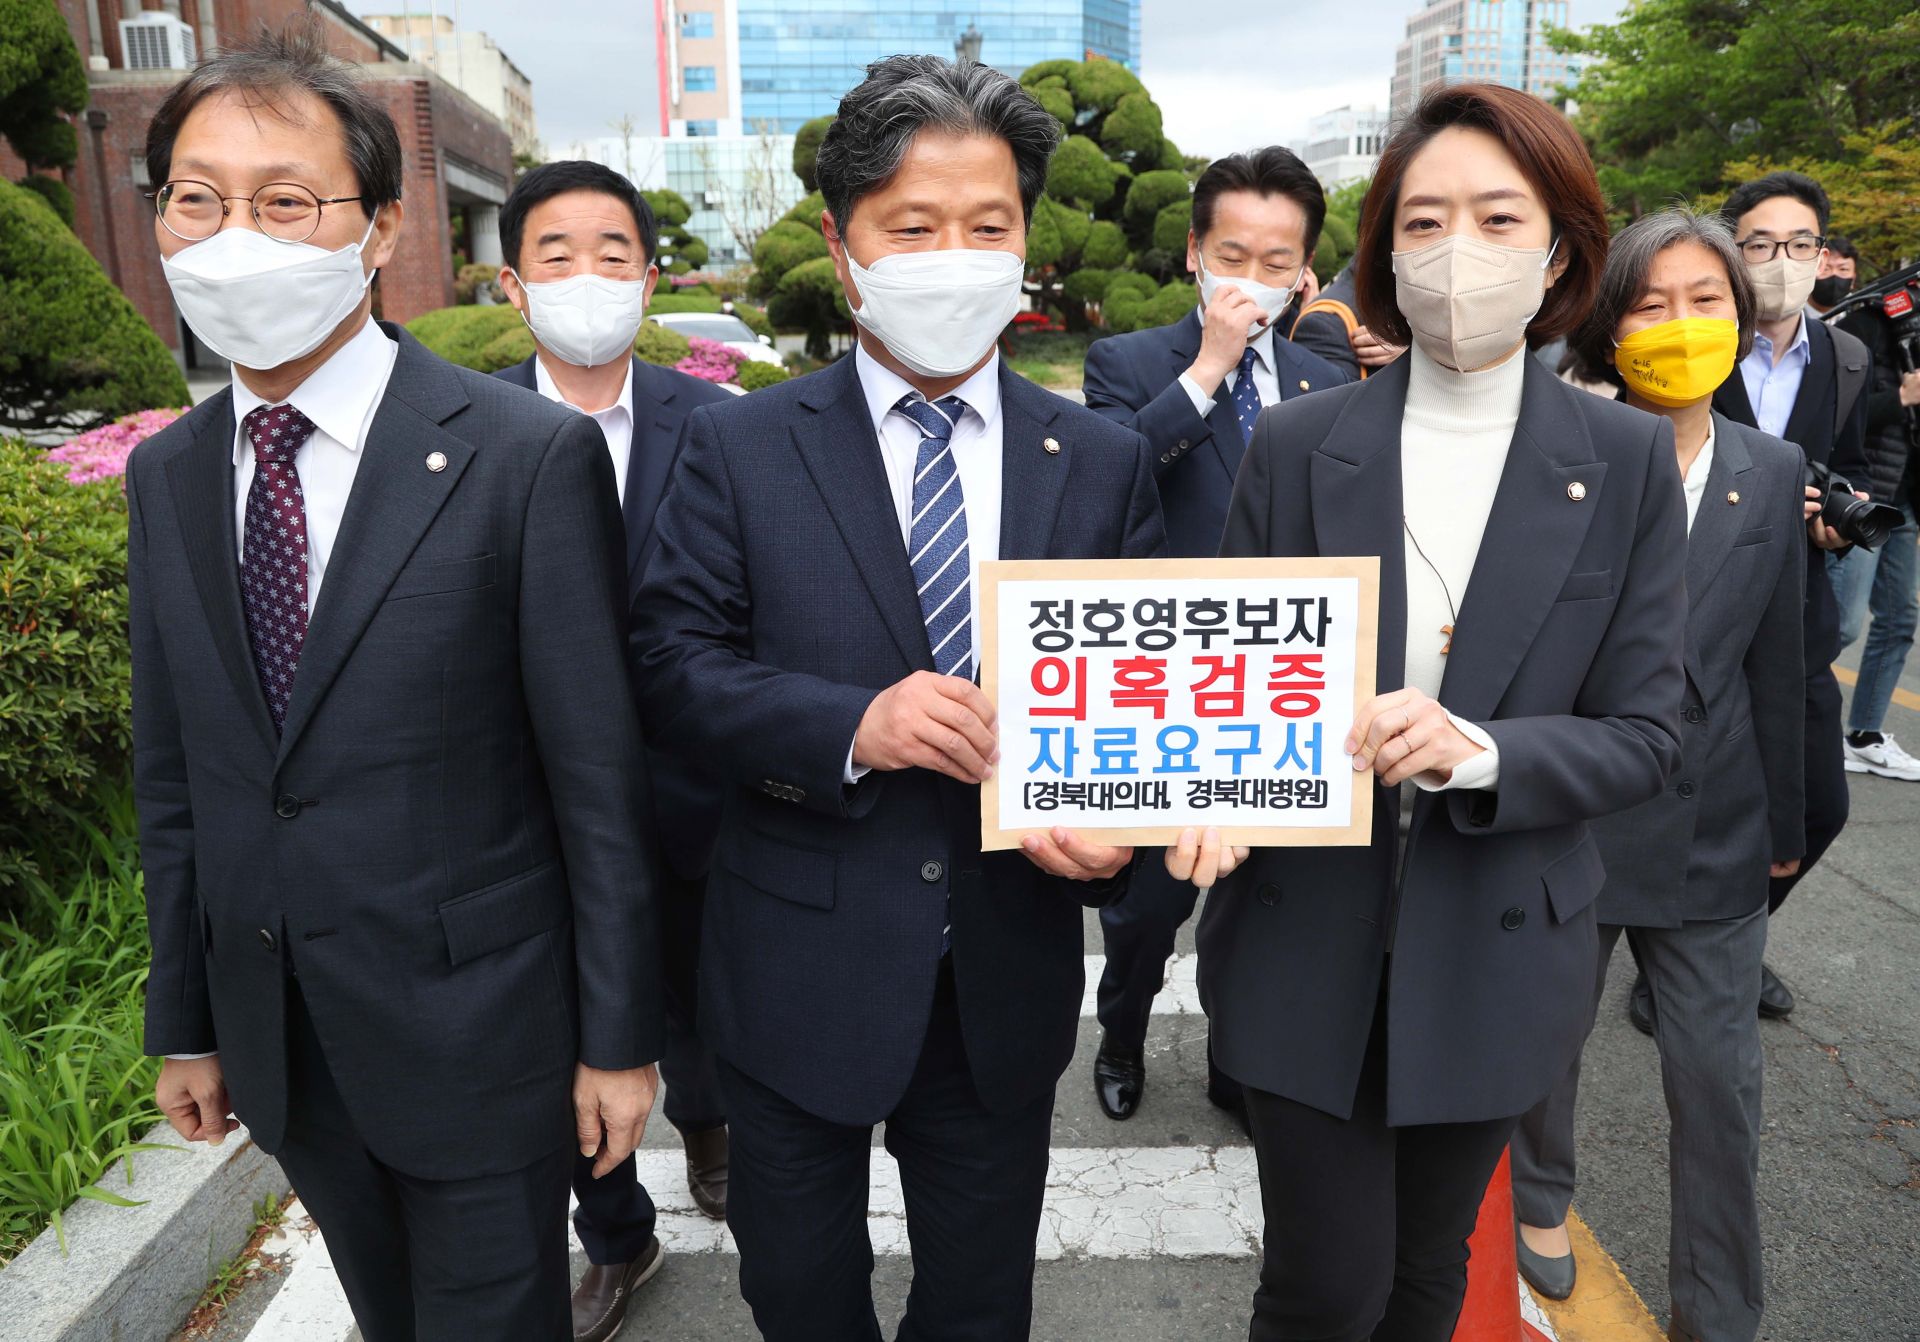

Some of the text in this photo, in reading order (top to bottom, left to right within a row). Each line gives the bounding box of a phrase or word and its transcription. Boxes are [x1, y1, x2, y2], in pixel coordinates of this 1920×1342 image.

[1028, 596, 1332, 653] 정호영후보자
[1028, 654, 1326, 721] 의혹검증
[1027, 722, 1323, 778] 자료요구서
